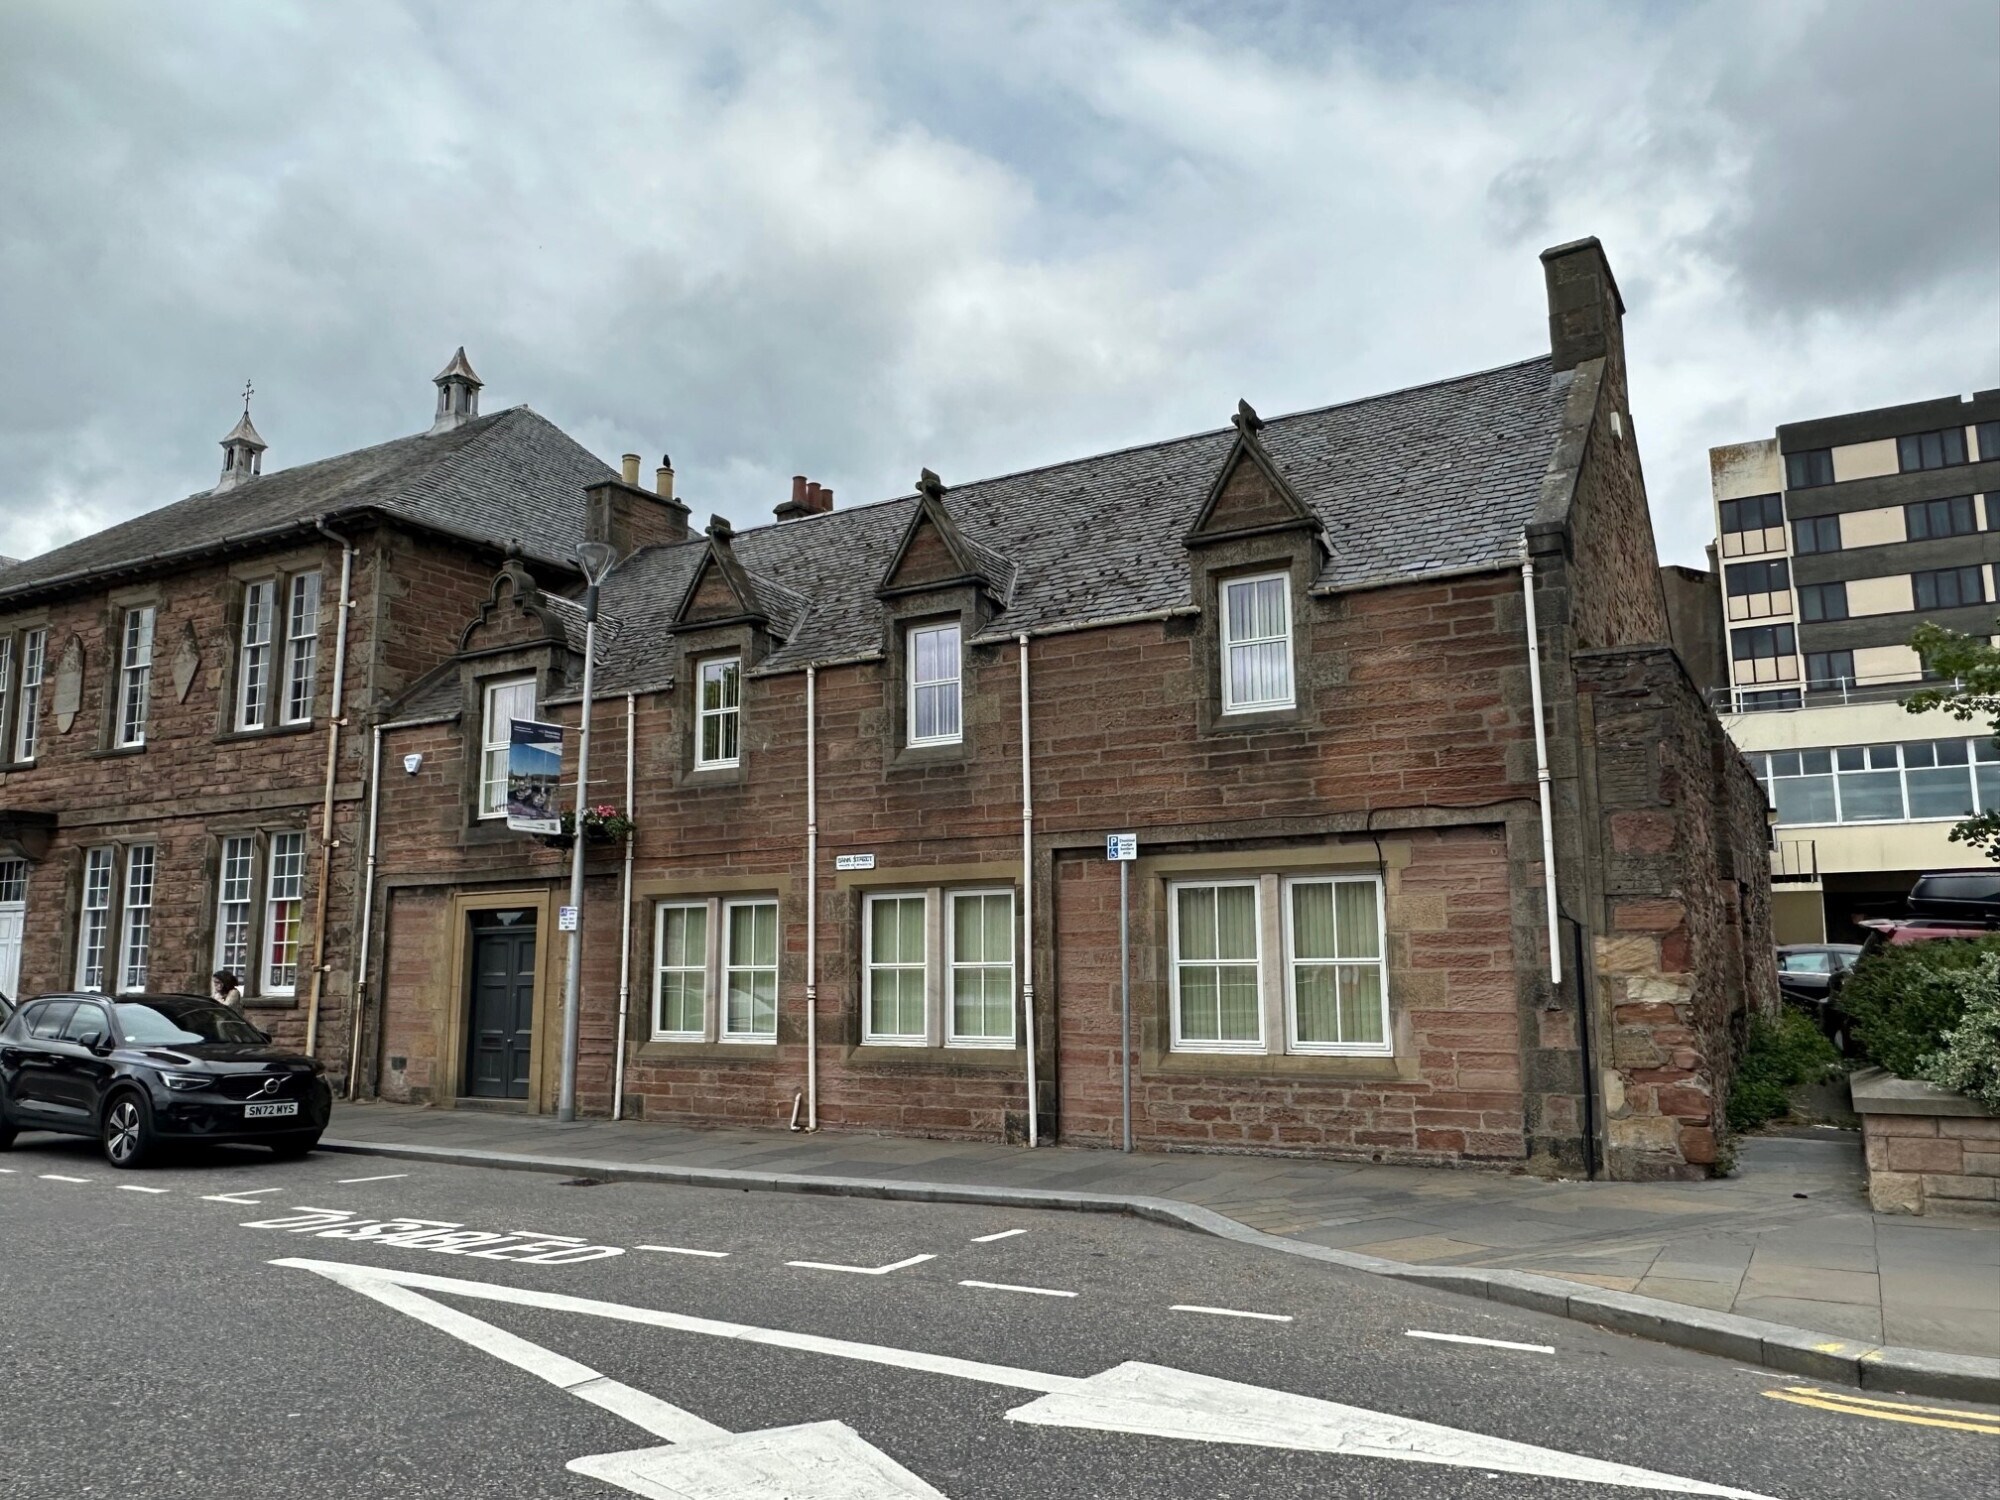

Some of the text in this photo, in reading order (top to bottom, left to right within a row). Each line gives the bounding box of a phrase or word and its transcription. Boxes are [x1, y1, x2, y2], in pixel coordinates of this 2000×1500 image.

[1110, 836, 1118, 846] P
[249, 1105, 275, 1116] SN72
[239, 1213, 626, 1265] DISABLED
